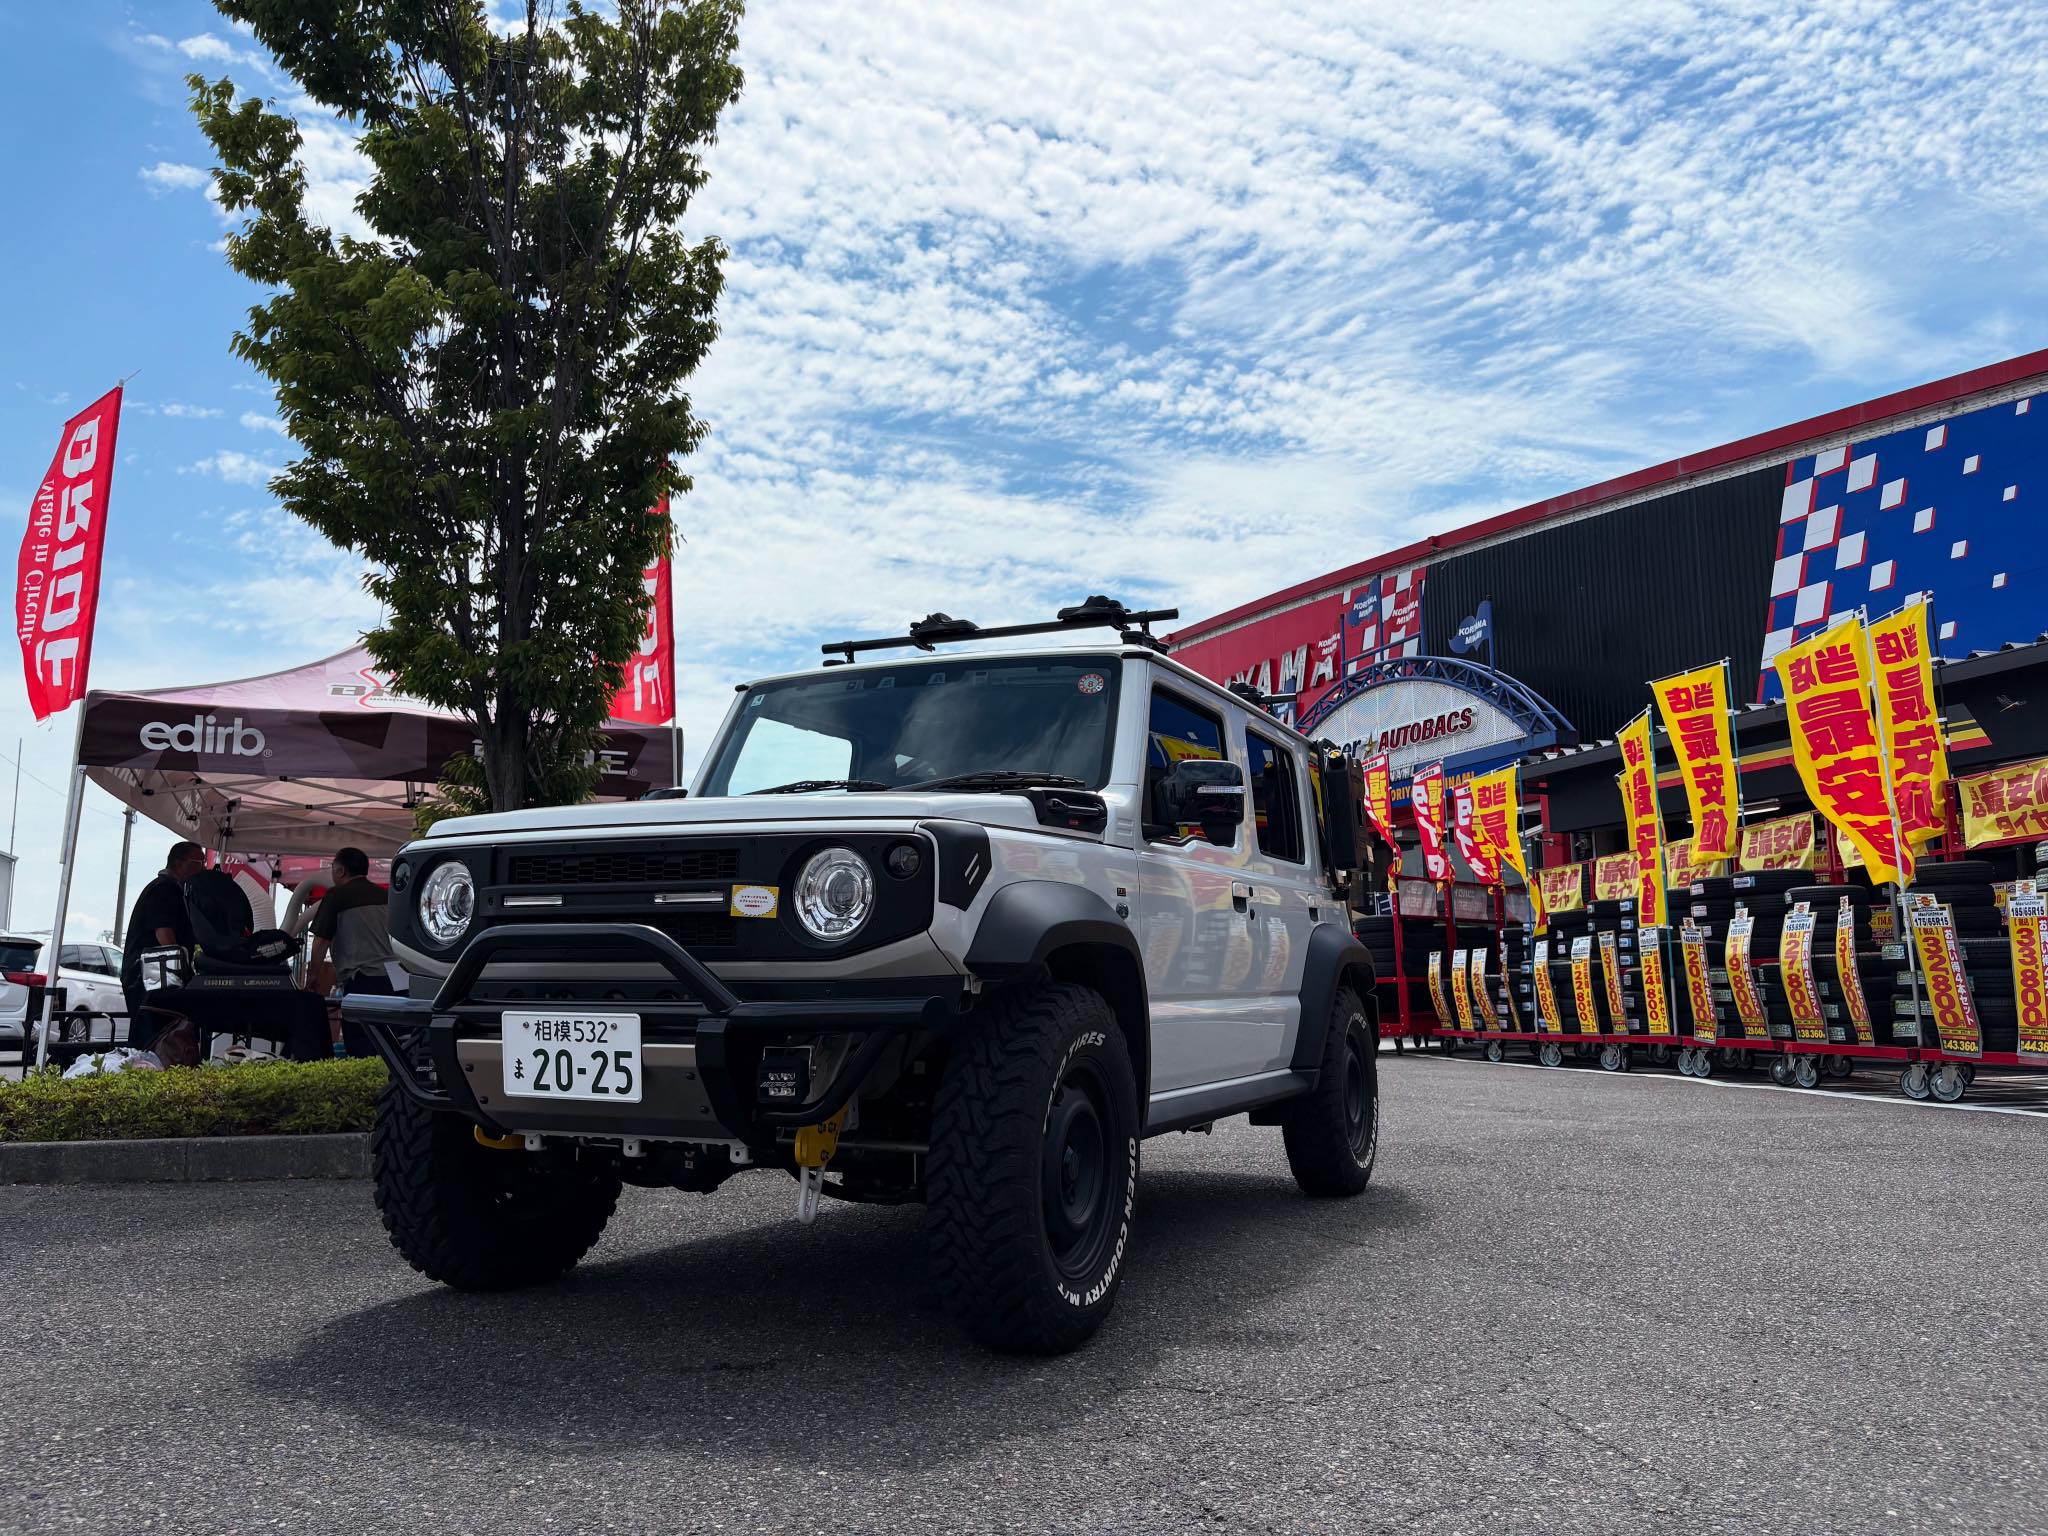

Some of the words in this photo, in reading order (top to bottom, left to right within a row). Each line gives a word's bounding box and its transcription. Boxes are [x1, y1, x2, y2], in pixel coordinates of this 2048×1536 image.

[139, 713, 266, 757] edirb
[1378, 707, 1474, 753] AUTOBACS
[1068, 1030, 1107, 1060] TIRES
[514, 1058, 525, 1080] ま
[532, 1048, 633, 1095] 20-25
[1125, 1137, 1137, 1220] OPEN
[1084, 1221, 1128, 1307] COUNTRY
